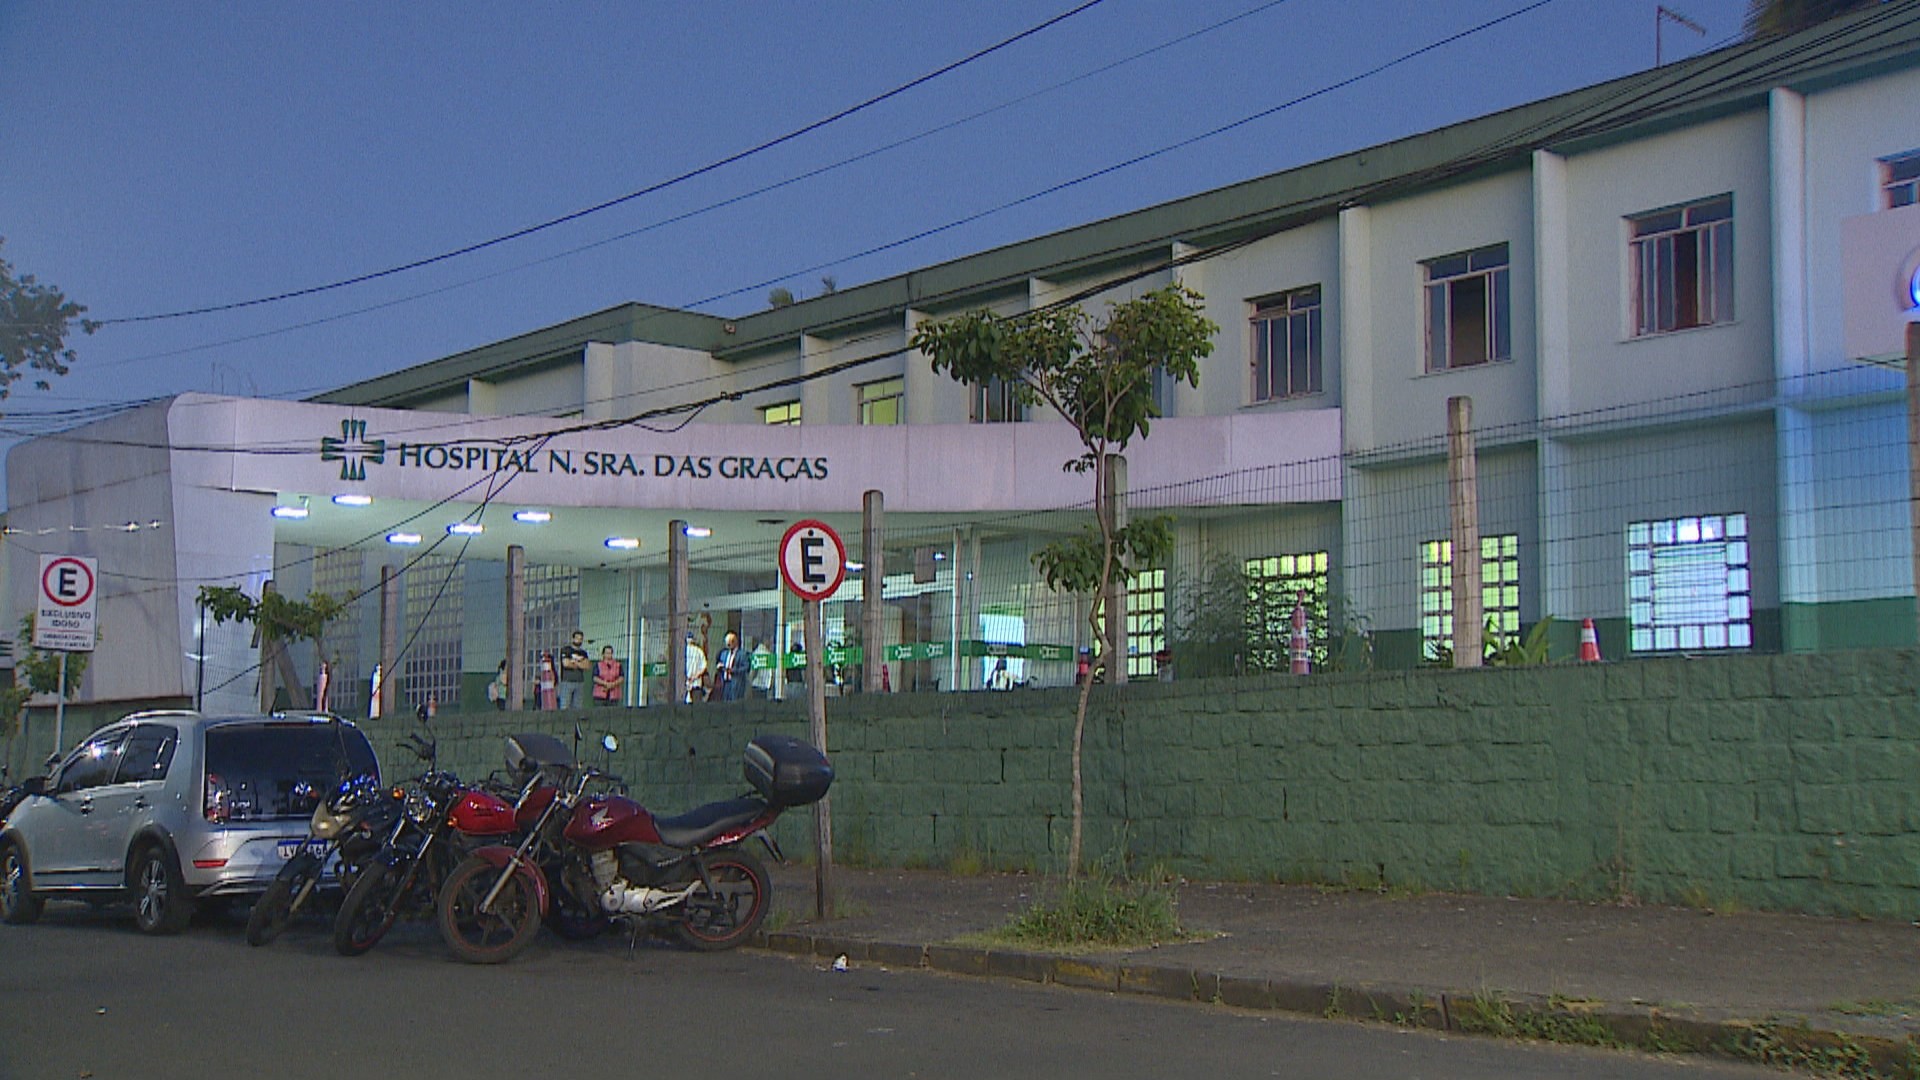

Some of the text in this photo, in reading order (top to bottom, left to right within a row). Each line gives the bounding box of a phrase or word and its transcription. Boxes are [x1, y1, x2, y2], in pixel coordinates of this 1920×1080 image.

[399, 442, 829, 483] HOSPITAL N. SRA. DAS GRAÇAS
[801, 537, 826, 583] E
[58, 568, 78, 596] E
[41, 609, 92, 620] EXCLUSIVO
[52, 619, 80, 629] IDOSO
